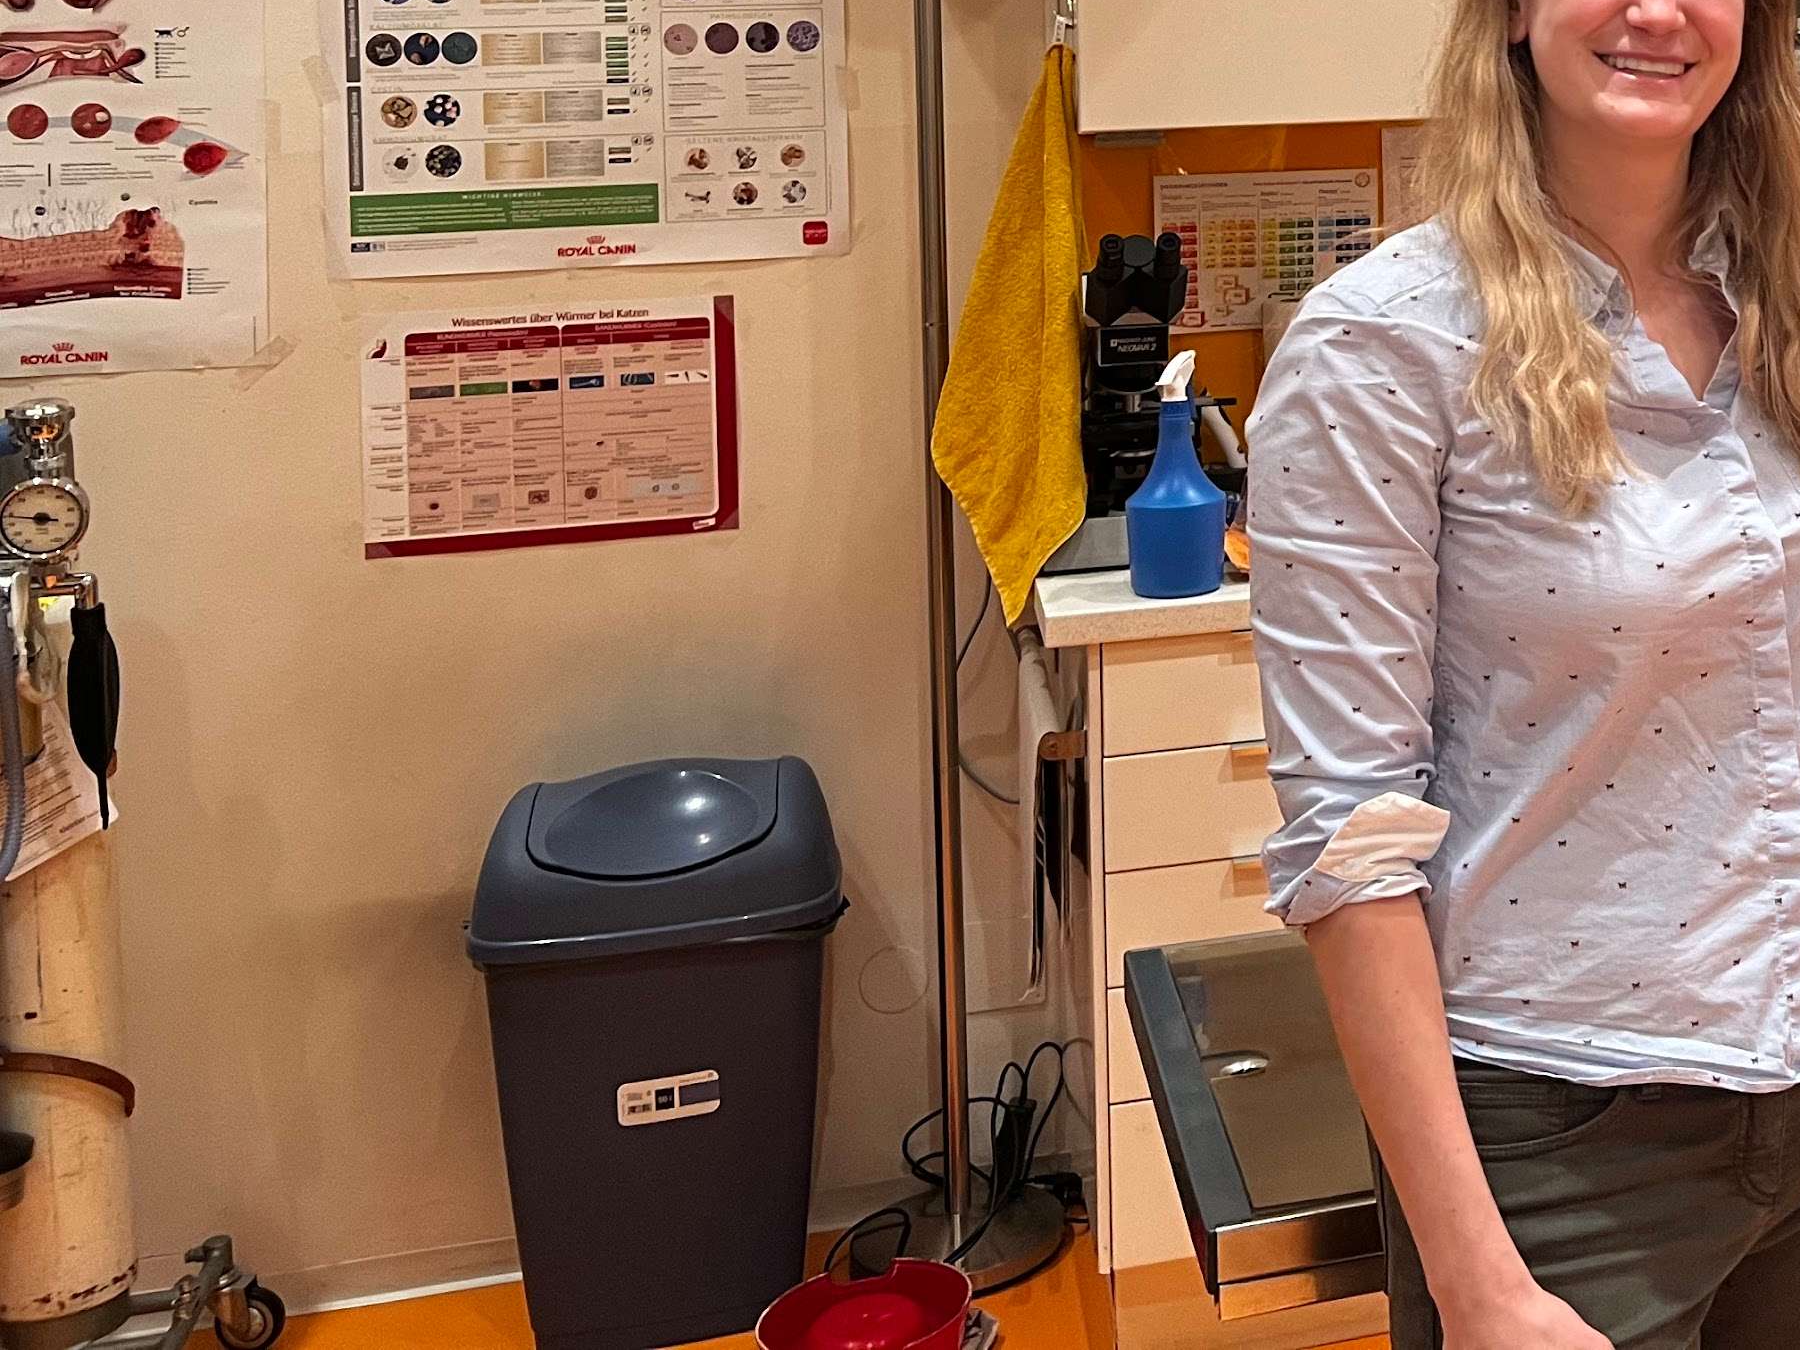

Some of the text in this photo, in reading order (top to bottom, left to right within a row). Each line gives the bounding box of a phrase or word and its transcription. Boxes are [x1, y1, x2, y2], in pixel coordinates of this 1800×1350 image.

[557, 244, 636, 257] ROYAL CANIN
[451, 308, 649, 327] Wissenswertes über Würmer bei Katzen
[20, 350, 109, 366] ROYAL CANIN
